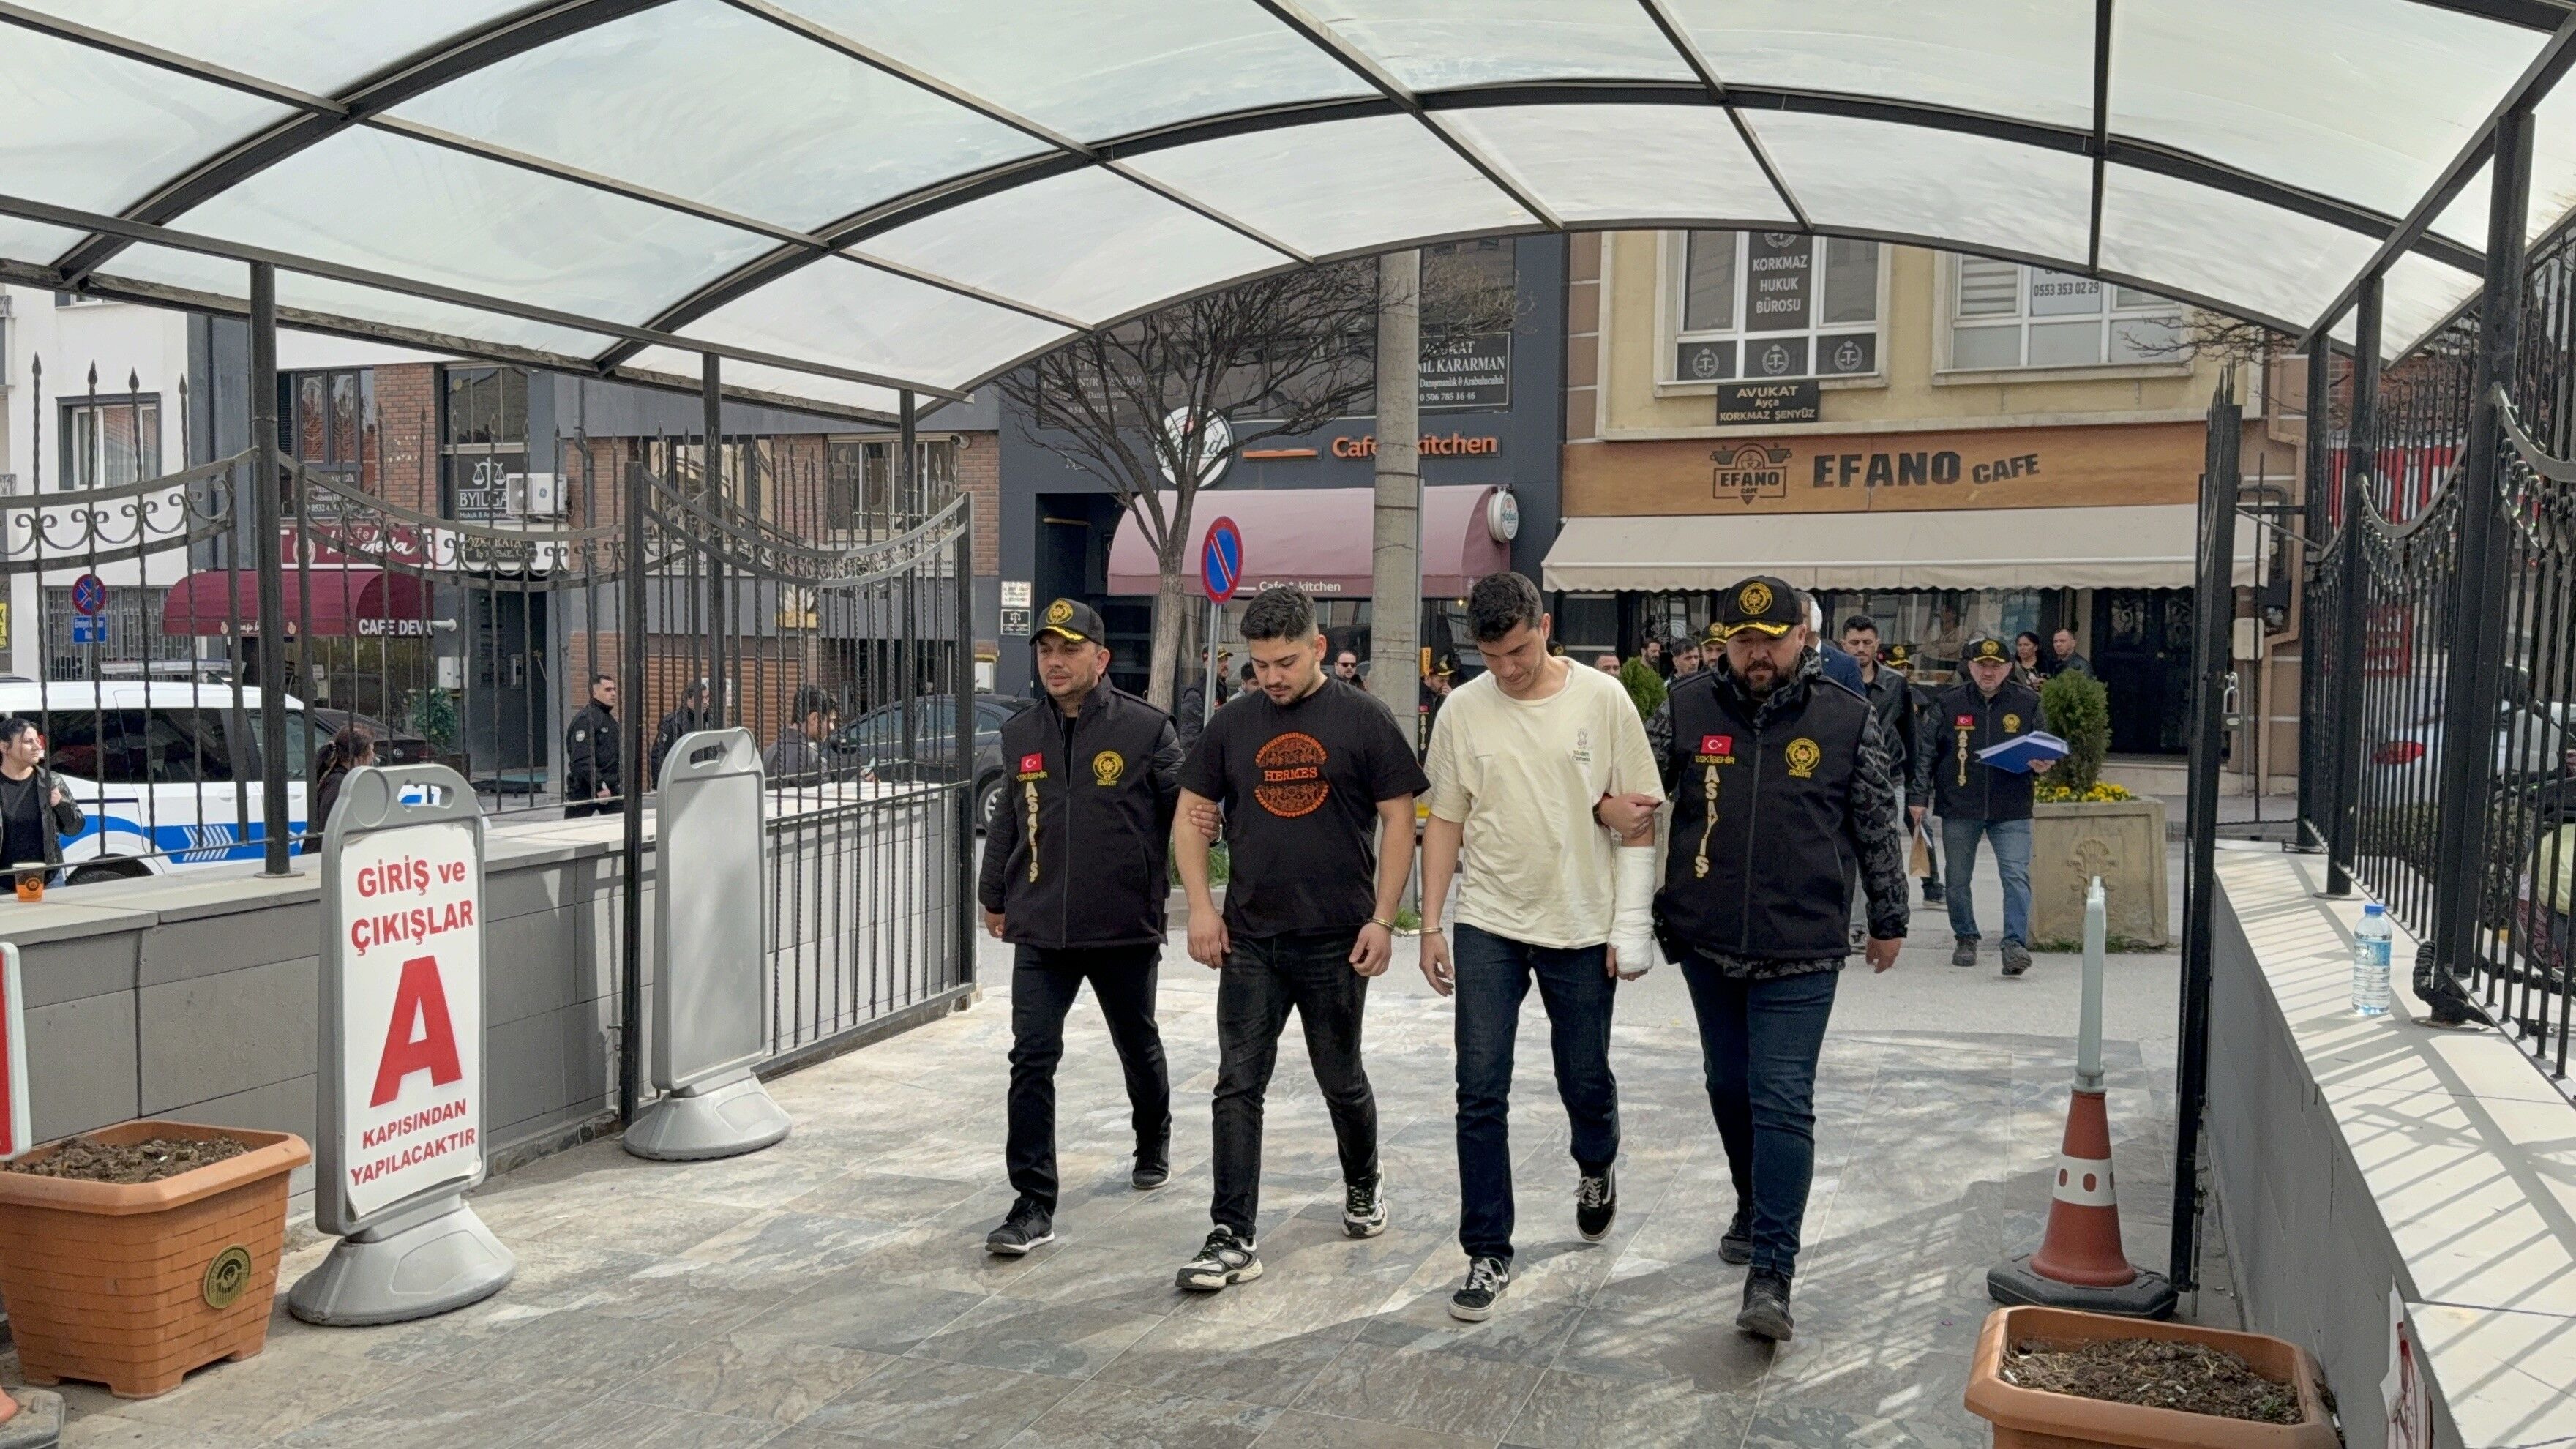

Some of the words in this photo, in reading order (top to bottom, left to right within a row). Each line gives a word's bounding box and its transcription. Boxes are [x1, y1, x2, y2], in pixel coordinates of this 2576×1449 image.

[1753, 255, 1808, 272] KORKMAZ
[1760, 277, 1799, 293] HUKUK
[2034, 283, 2055, 296] 0553
[2057, 282, 2073, 296] 353
[2075, 282, 2086, 294] 02
[2088, 281, 2100, 293] 29
[1756, 296, 1801, 314] BÜROSU
[1437, 356, 1505, 372] KARARMAN
[1419, 394, 1425, 402] 0
[1426, 393, 1439, 402] 506
[1441, 392, 1454, 401] 785
[1456, 392, 1464, 400] 16
[1466, 391, 1476, 400] 46
[1736, 385, 1798, 399] AVUKAT
[1755, 398, 1779, 409] Ayça
[1719, 411, 1770, 421] KORKMAZ
[1775, 407, 1815, 422] ŞENYÜZ
[1813, 452, 1961, 488] EFANO
[1972, 453, 2040, 484] CAFE
[1721, 471, 1780, 487] EFANO
[1299, 581, 1341, 592] kitchen
[359, 619, 395, 634] CAFE
[1264, 766, 1318, 782] HERMES
[357, 855, 430, 897] GİRİŞ
[438, 861, 466, 884] ve
[351, 899, 474, 957] ÇIKIŞLAR
[369, 955, 463, 1109] A
[362, 1098, 466, 1150] KAPISINDAN
[351, 1128, 476, 1186] YAPILACAKTIR
